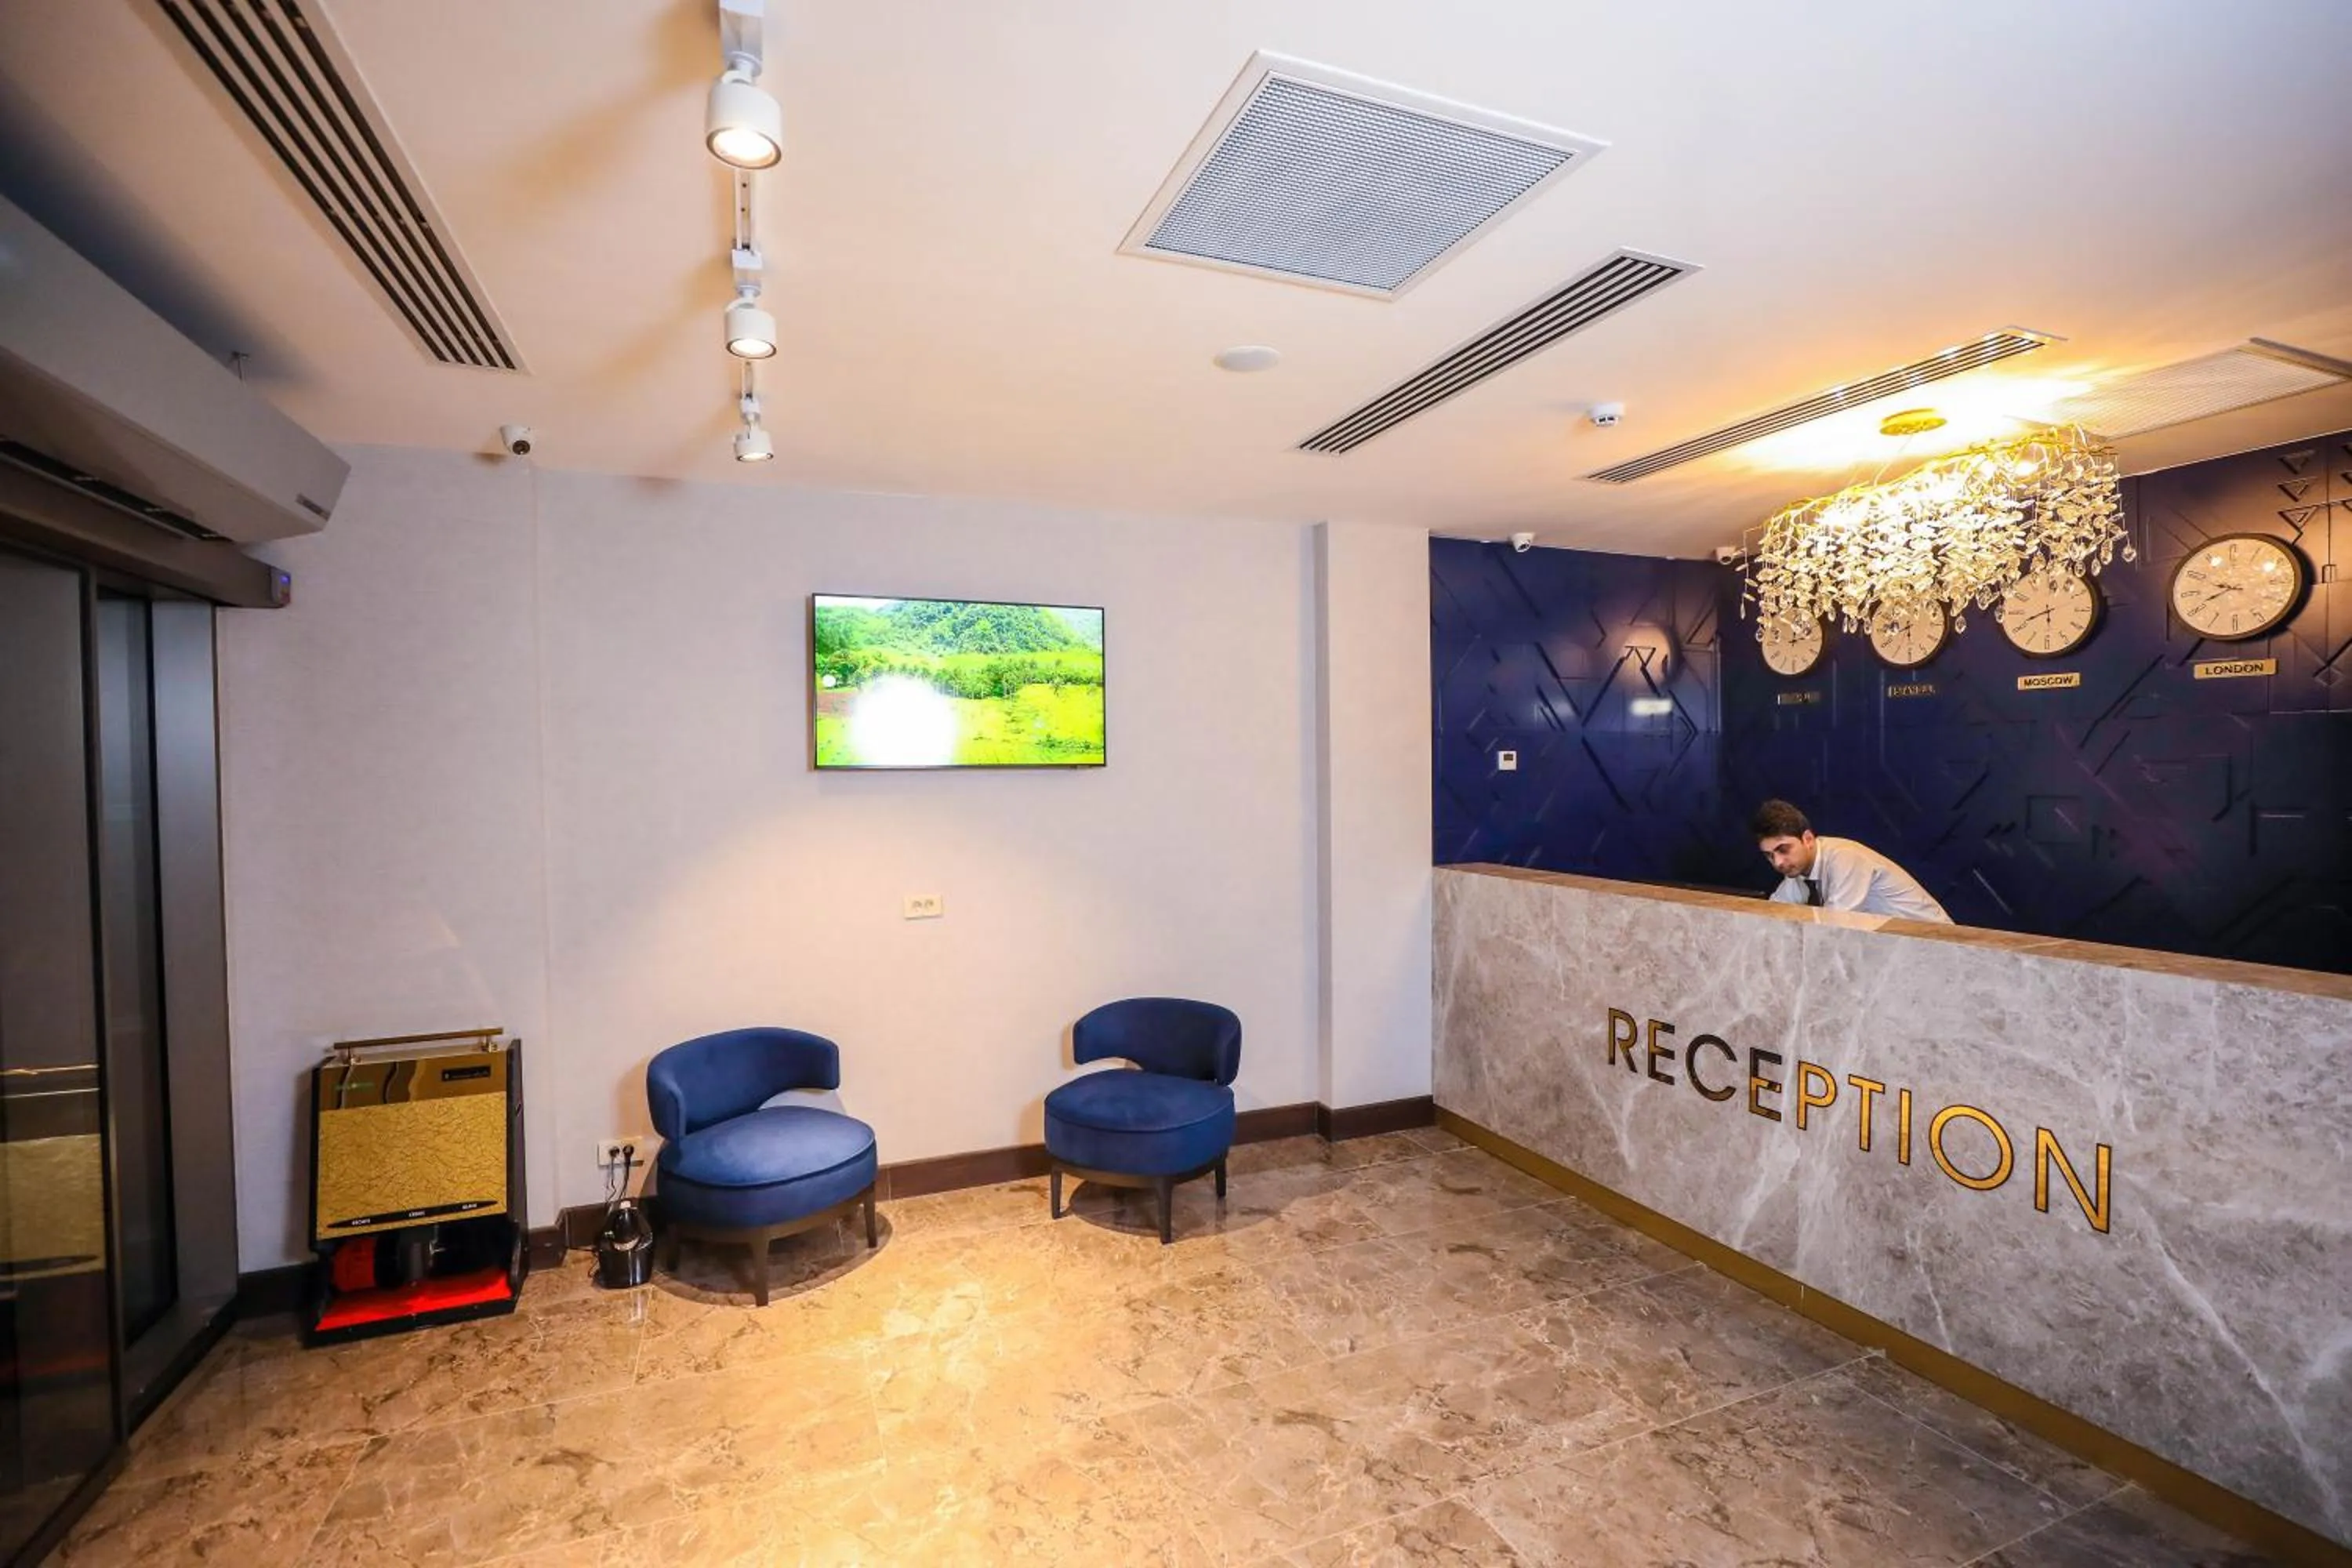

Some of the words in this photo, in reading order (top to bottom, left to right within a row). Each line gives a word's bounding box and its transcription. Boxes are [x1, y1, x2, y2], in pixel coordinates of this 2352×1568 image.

[2205, 662, 2264, 676] LONDON
[2024, 675, 2074, 686] MOSCOW
[1607, 1007, 2111, 1233] RECEPTION
